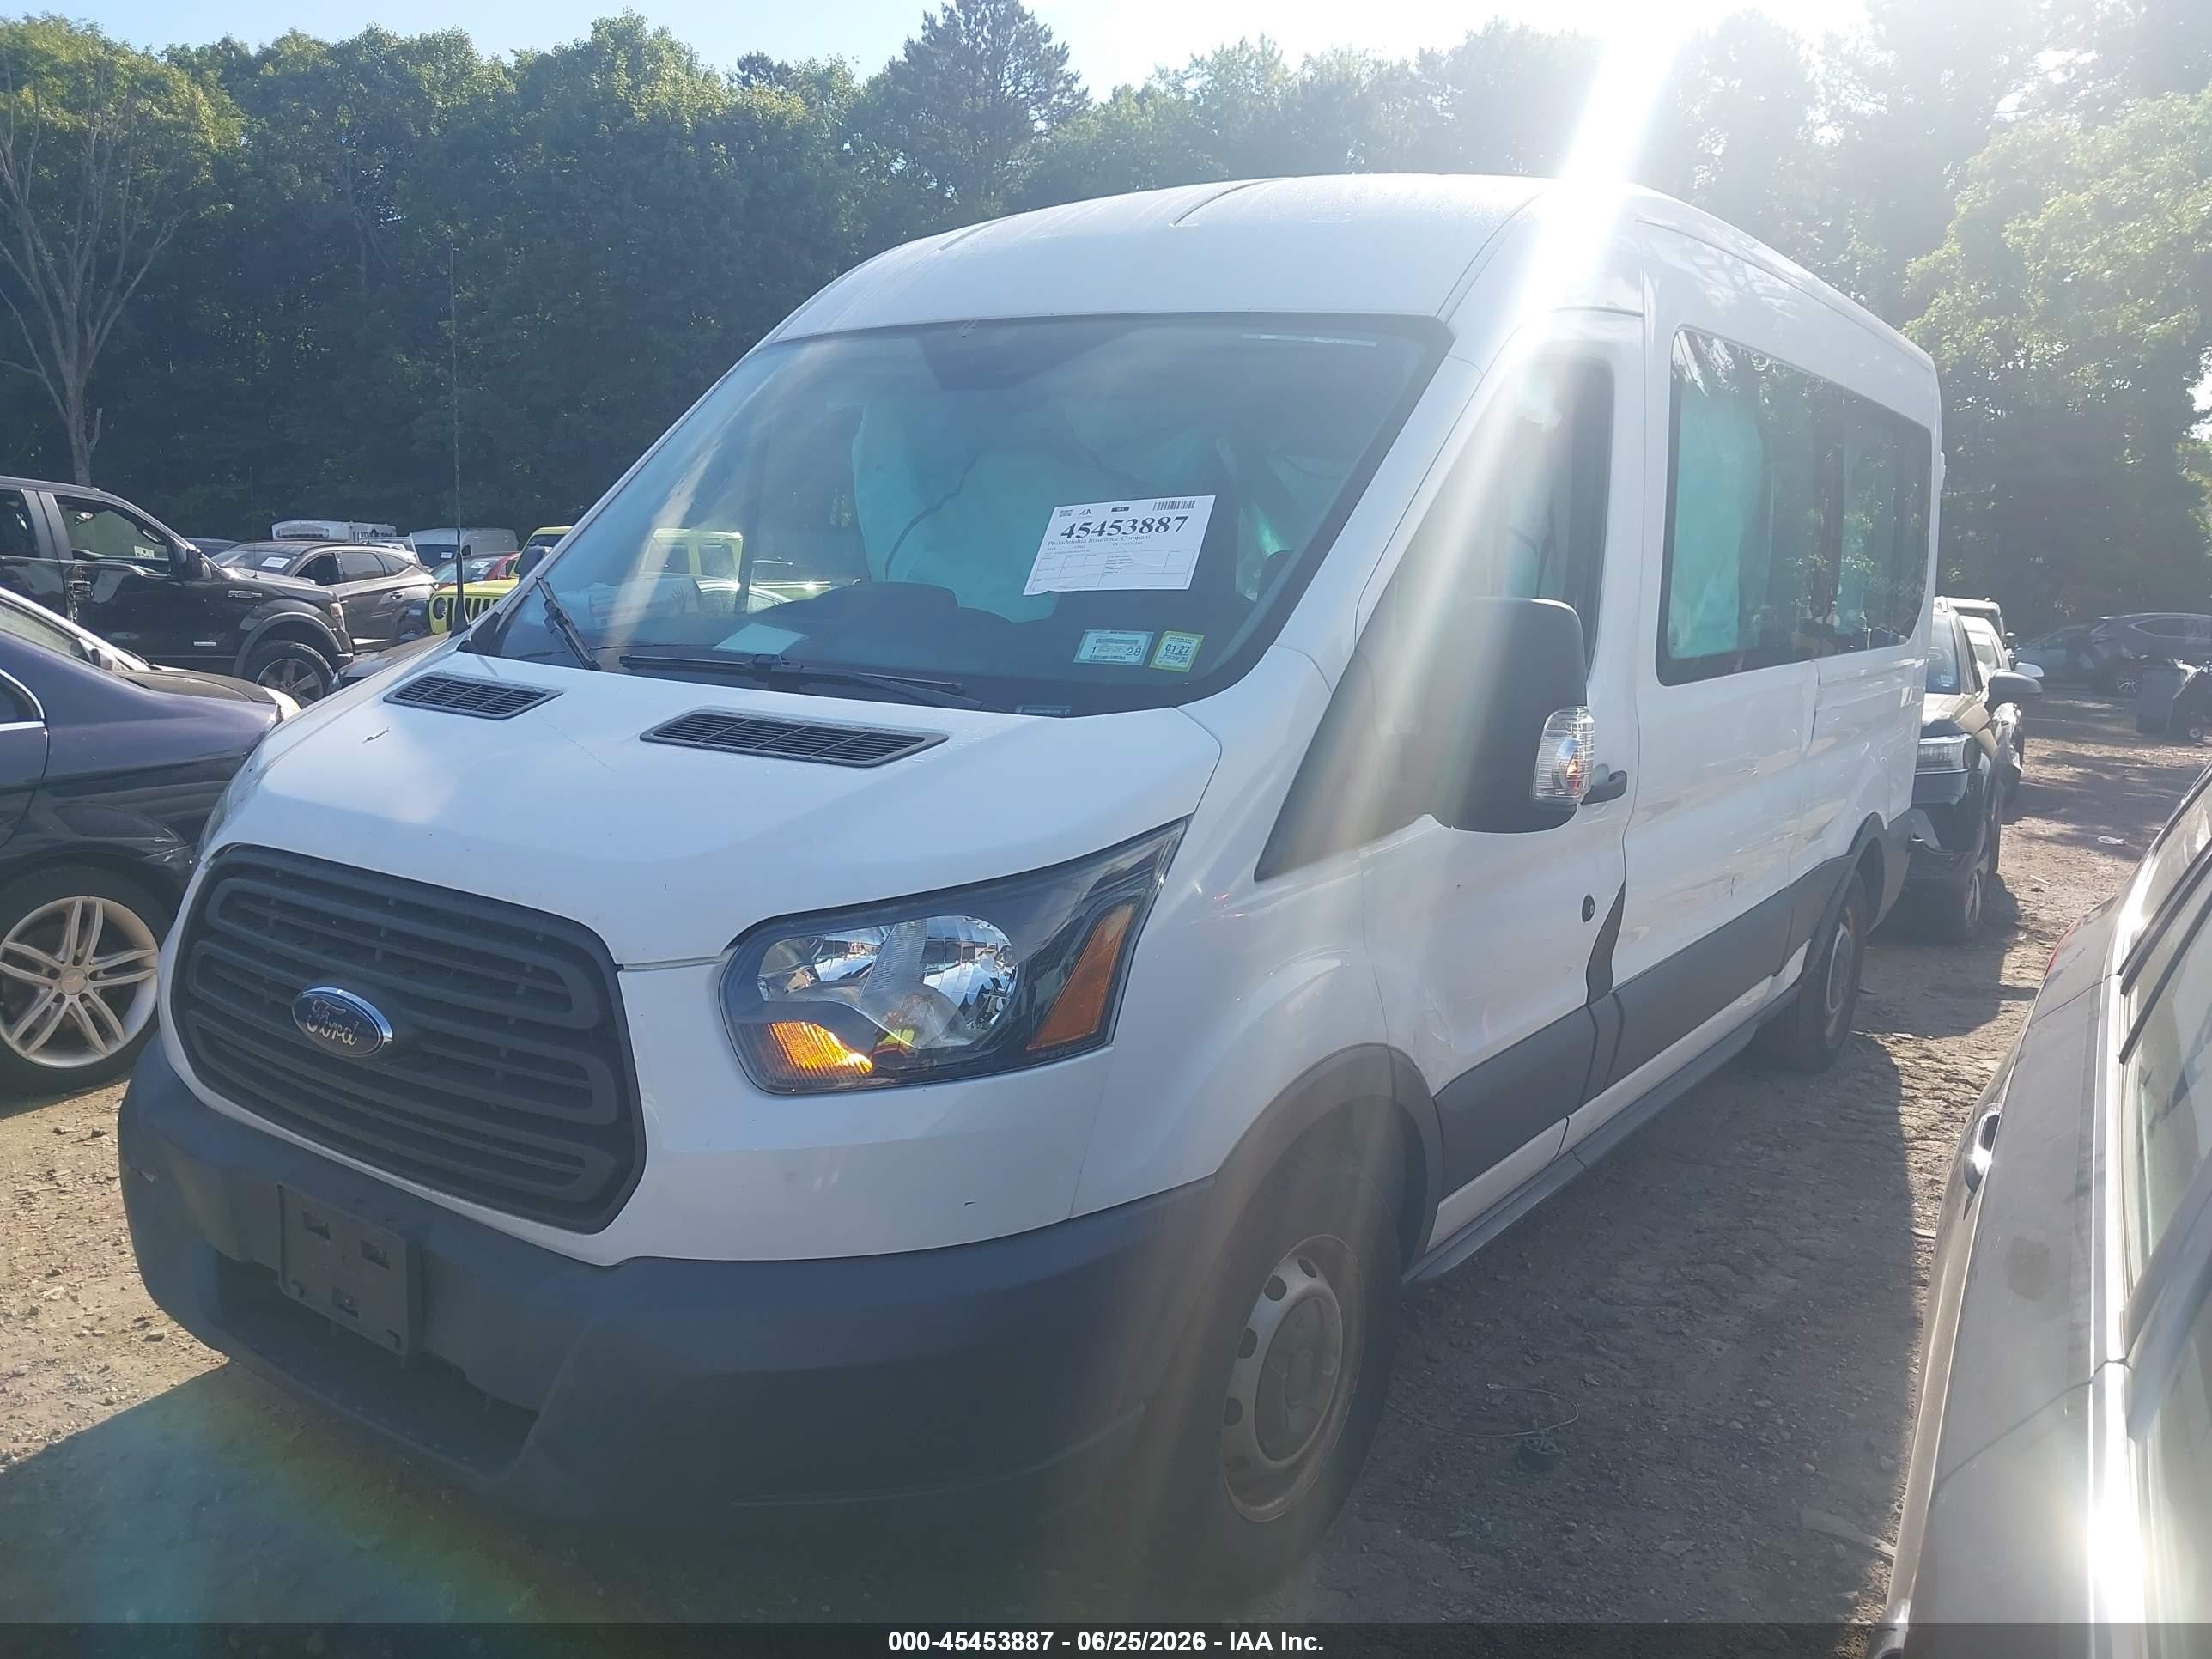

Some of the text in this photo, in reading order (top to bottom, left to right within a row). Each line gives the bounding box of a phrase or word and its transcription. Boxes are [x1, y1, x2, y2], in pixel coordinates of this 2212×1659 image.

[1060, 515, 1189, 539] 45453887
[1047, 538, 1087, 547] Philadelphia
[306, 998, 360, 1047] Ford
